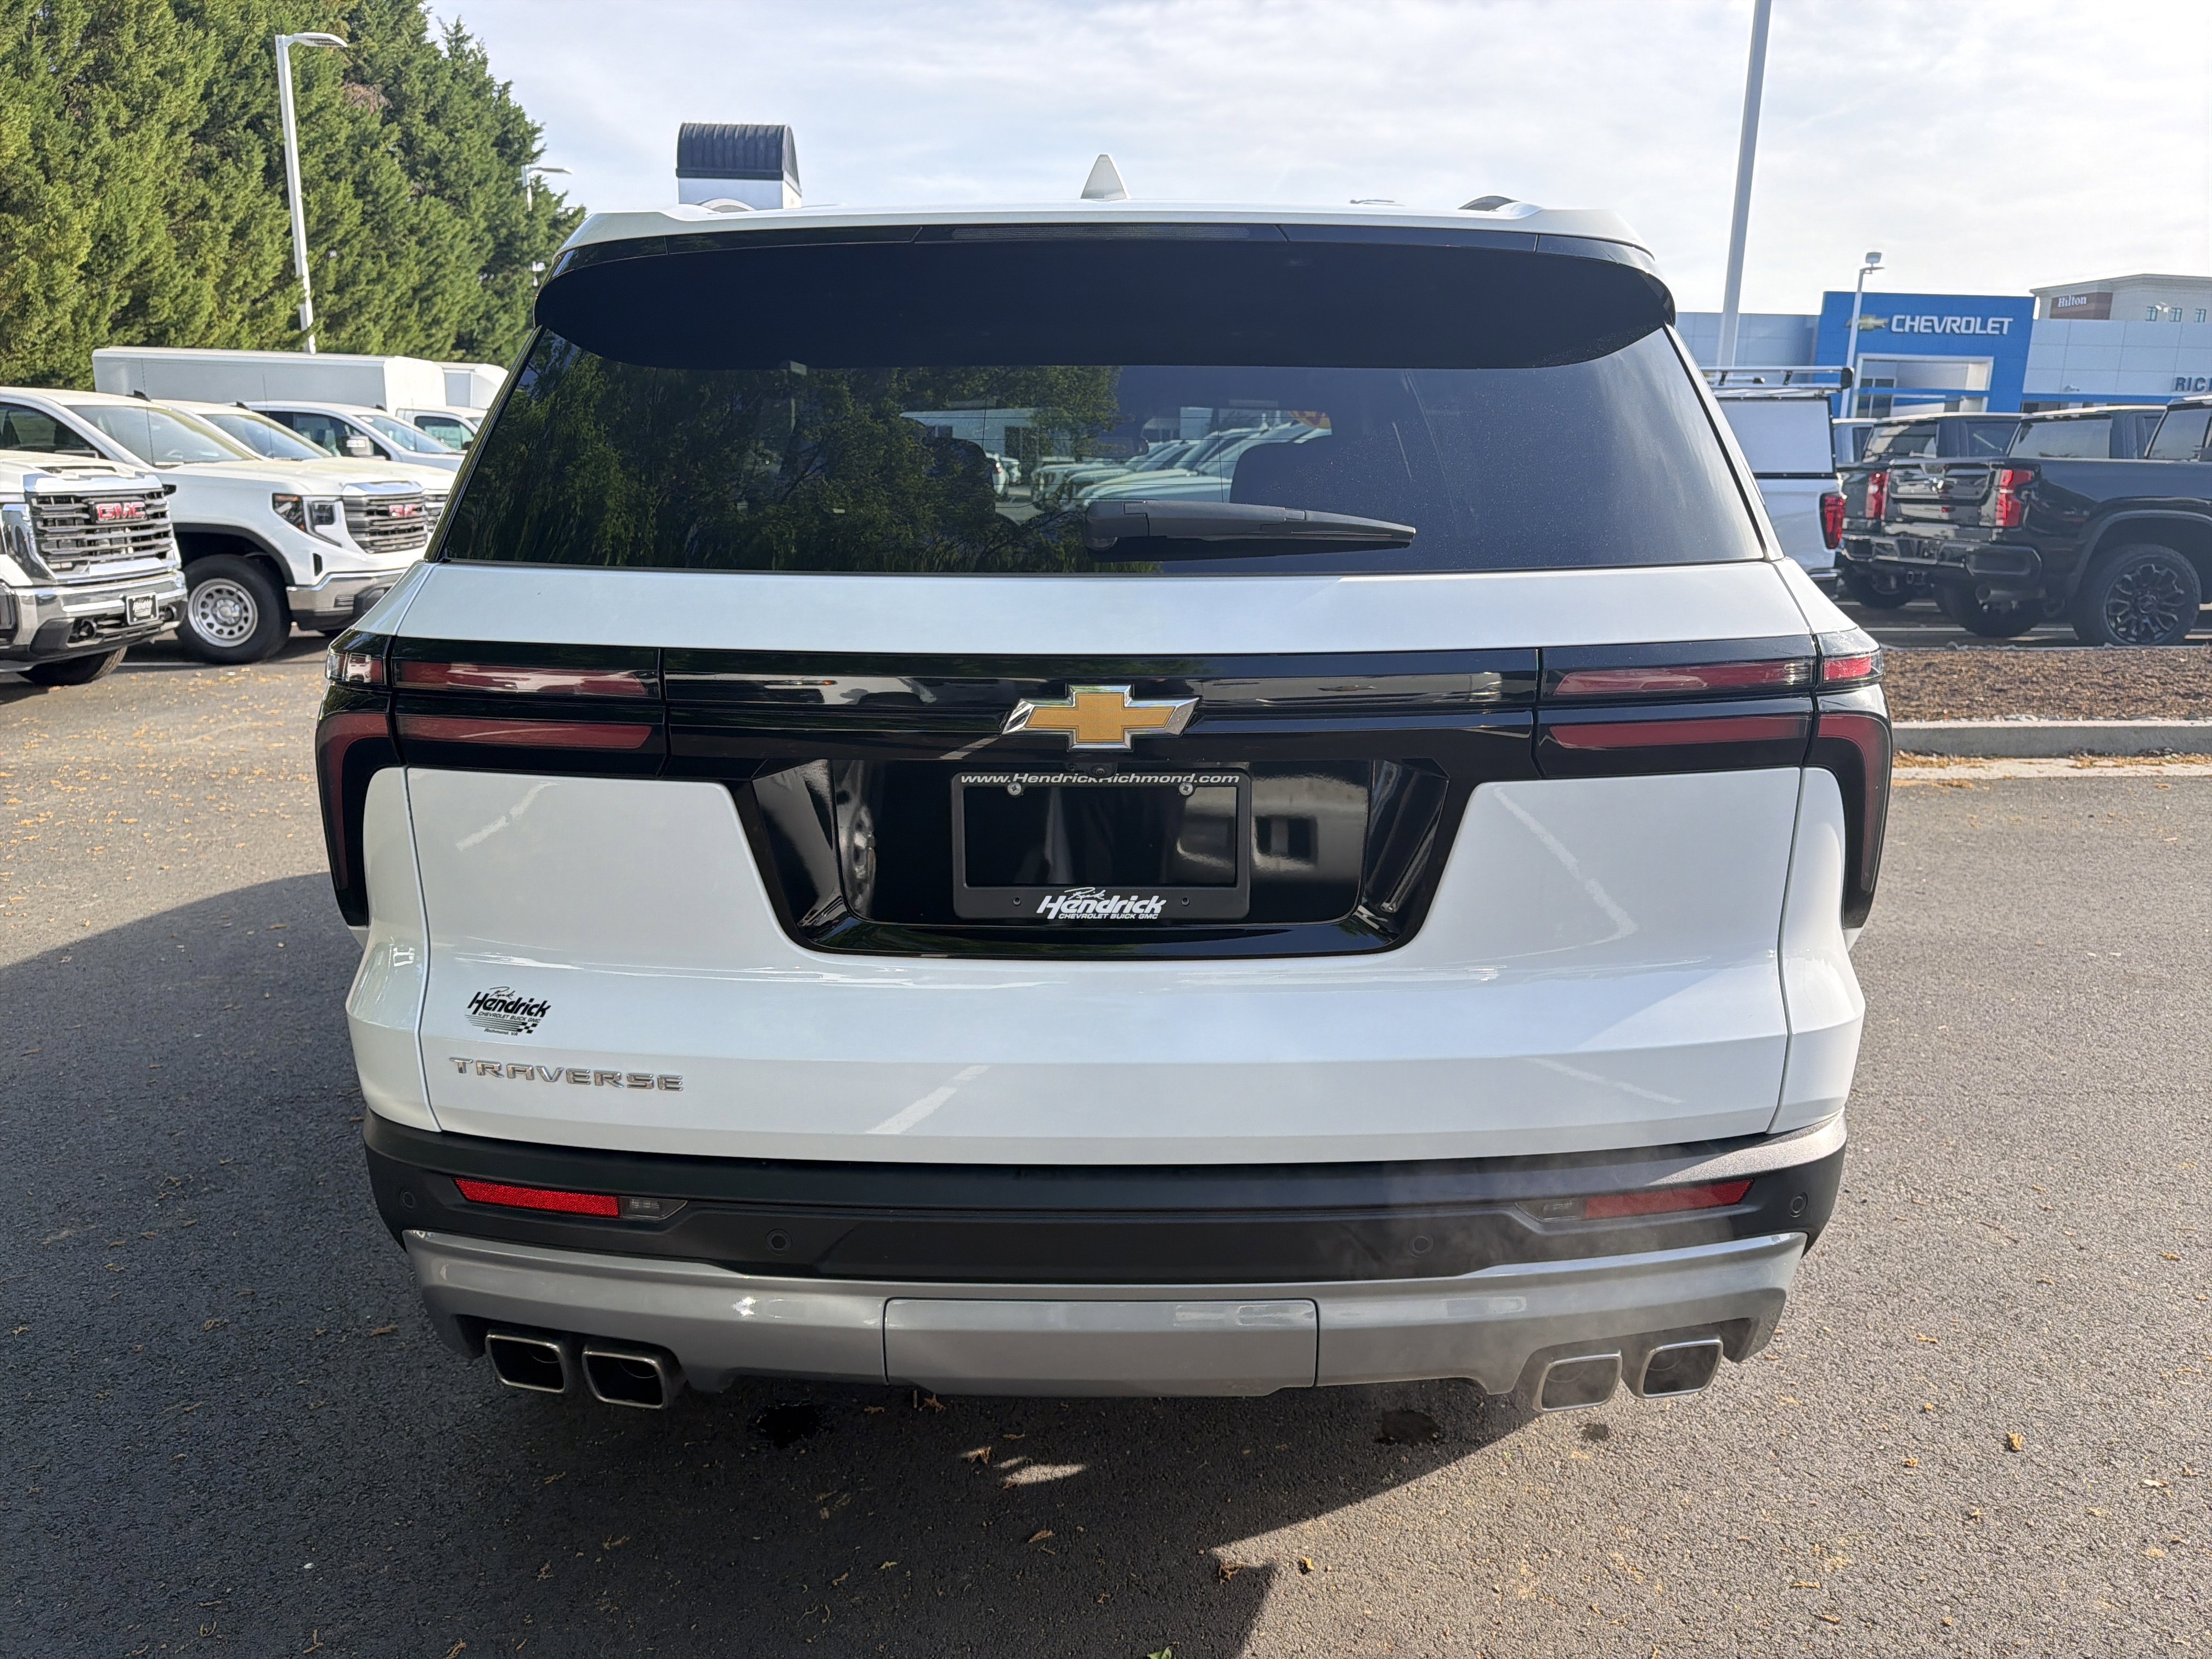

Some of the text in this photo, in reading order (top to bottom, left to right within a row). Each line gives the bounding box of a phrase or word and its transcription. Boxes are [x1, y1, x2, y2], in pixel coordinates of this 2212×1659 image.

[2058, 294, 2087, 307] Hilton
[1891, 315, 2013, 335] CHEVROLET
[97, 501, 145, 519] GMC
[1036, 895, 1167, 919] Hendrick
[466, 991, 551, 1018] Hendrick
[478, 1011, 509, 1019] CHEVROLET
[449, 1056, 684, 1091] TRAVERSE
